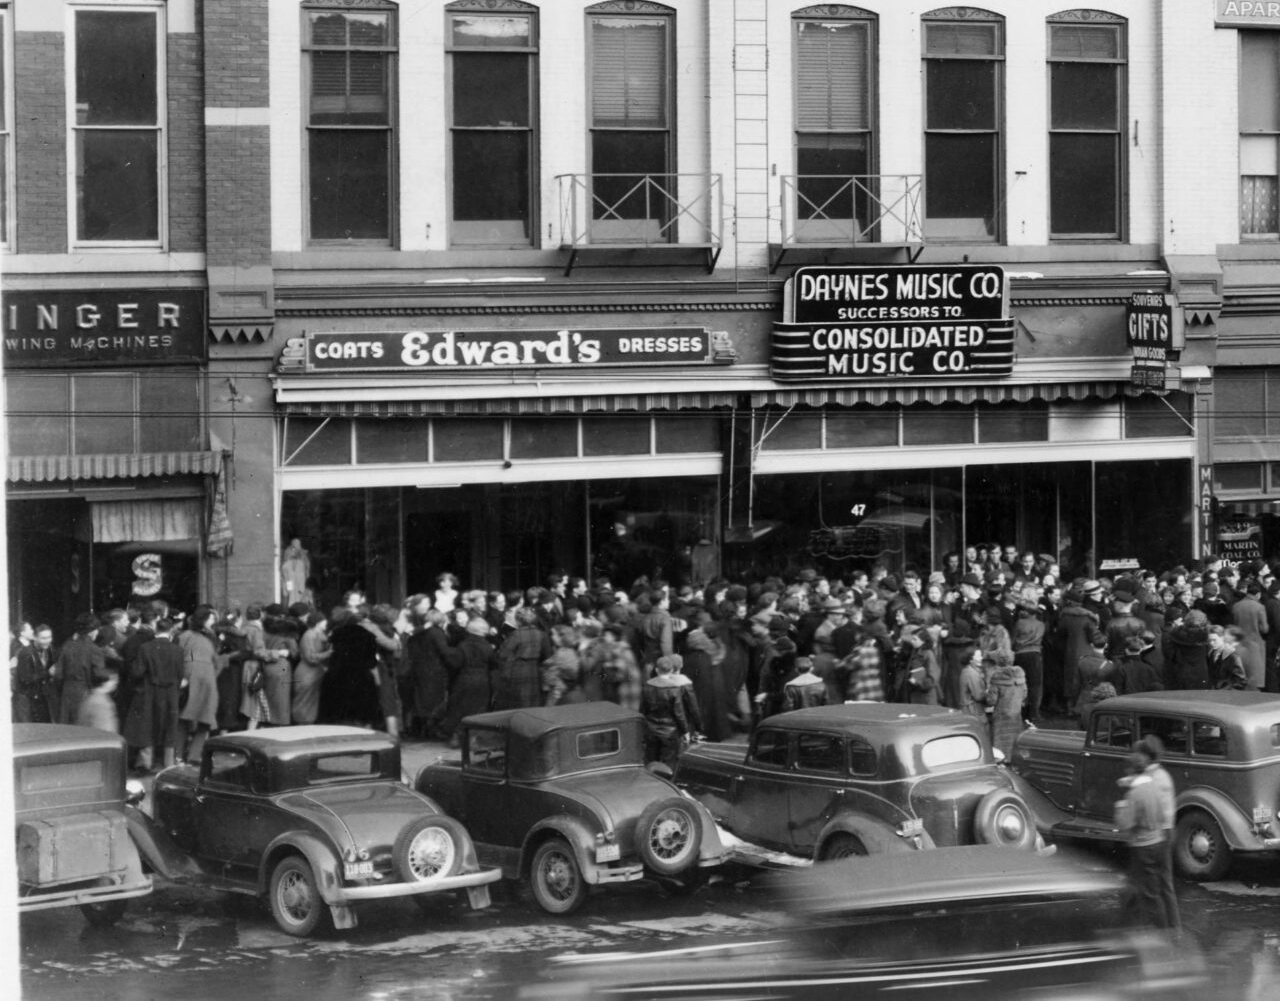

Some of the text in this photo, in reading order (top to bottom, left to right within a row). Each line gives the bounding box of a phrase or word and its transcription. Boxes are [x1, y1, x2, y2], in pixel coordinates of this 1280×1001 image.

[800, 272, 1002, 301] DAYNES MUSIC CO.
[837, 305, 963, 319] SUCCESSORS TO
[1132, 294, 1163, 307] SOUVENIRS
[9, 302, 181, 331] INGER
[1129, 312, 1168, 341] GIFTS
[6, 335, 173, 350] WING MACHINES
[314, 341, 385, 360] COATS
[400, 331, 601, 366] Edward's
[618, 336, 703, 354] DRESSES
[812, 325, 984, 351] CONSOLIDATED
[828, 350, 970, 375] MUSIC CO.
[850, 504, 866, 516] 47
[1201, 467, 1212, 556] MARTIN
[1223, 541, 1259, 550] MARTIN
[131, 553, 163, 596] S
